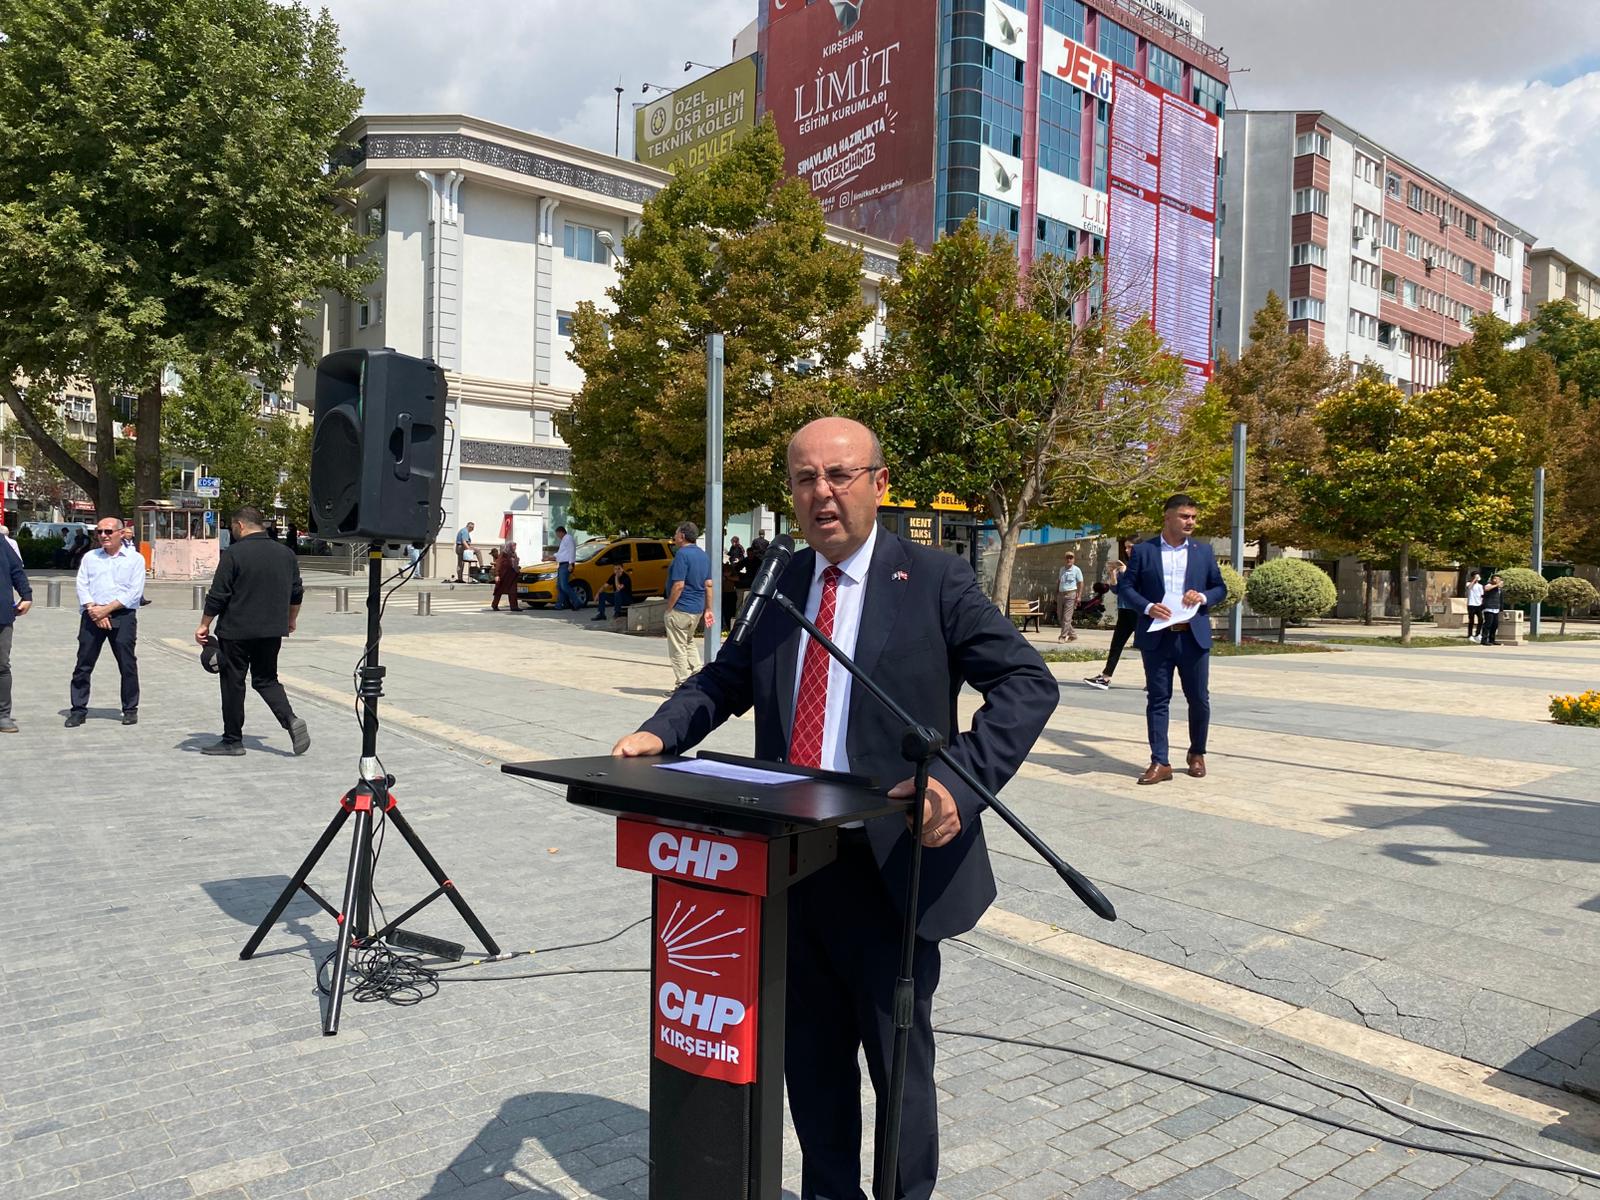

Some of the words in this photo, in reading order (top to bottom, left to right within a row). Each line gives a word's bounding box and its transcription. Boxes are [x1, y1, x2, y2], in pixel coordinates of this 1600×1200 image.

[822, 30, 864, 58] KIRŞEHİR
[1057, 38, 1109, 89] JET
[675, 90, 708, 115] ÖZEL
[794, 41, 900, 123] LİMİT
[1091, 71, 1112, 99] KÜ
[647, 129, 693, 159] TEKNİK
[697, 103, 744, 139] KOLEJİ
[674, 109, 701, 131] OSB
[705, 88, 745, 119] BİLİM
[799, 114, 829, 136] EĞİTİM
[832, 89, 887, 123] KURUMLARI
[688, 128, 736, 169] DEVLET
[797, 143, 838, 175] SINAVLARA
[838, 117, 886, 153] HAZIRLIKTA
[910, 517, 932, 528] KENT
[648, 831, 739, 881] CHP
[658, 981, 746, 1034] CHP
[660, 1024, 740, 1065] KIRŞEHİR
